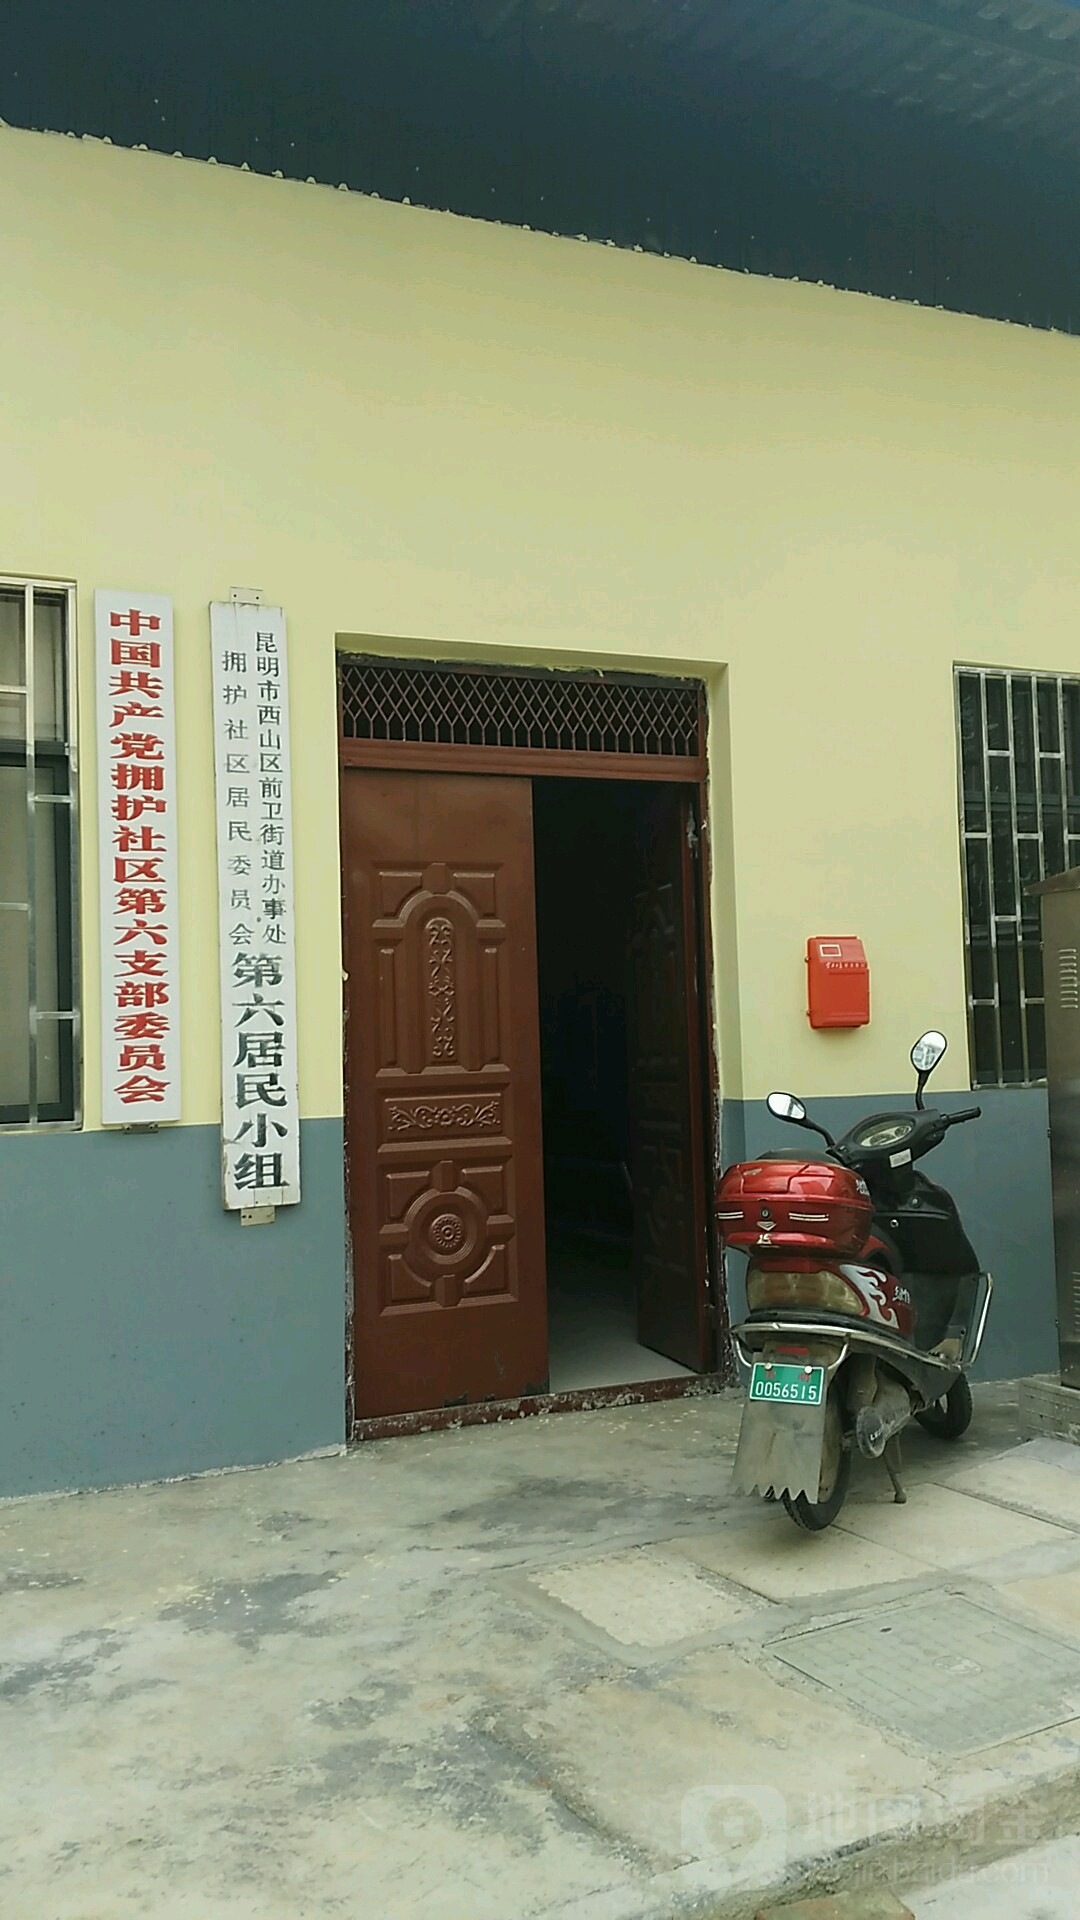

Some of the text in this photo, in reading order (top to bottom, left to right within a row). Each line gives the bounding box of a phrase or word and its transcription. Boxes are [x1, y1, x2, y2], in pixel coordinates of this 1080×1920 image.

[109, 609, 171, 1104] 中国共产党拥护社区第六支部委员会
[221, 650, 255, 945] 拥护社区居民委员会
[255, 631, 287, 944] 昆明市西山区前卫街道办事处
[231, 952, 290, 1190] 第六居民小组
[755, 1381, 817, 1400] 0056515
